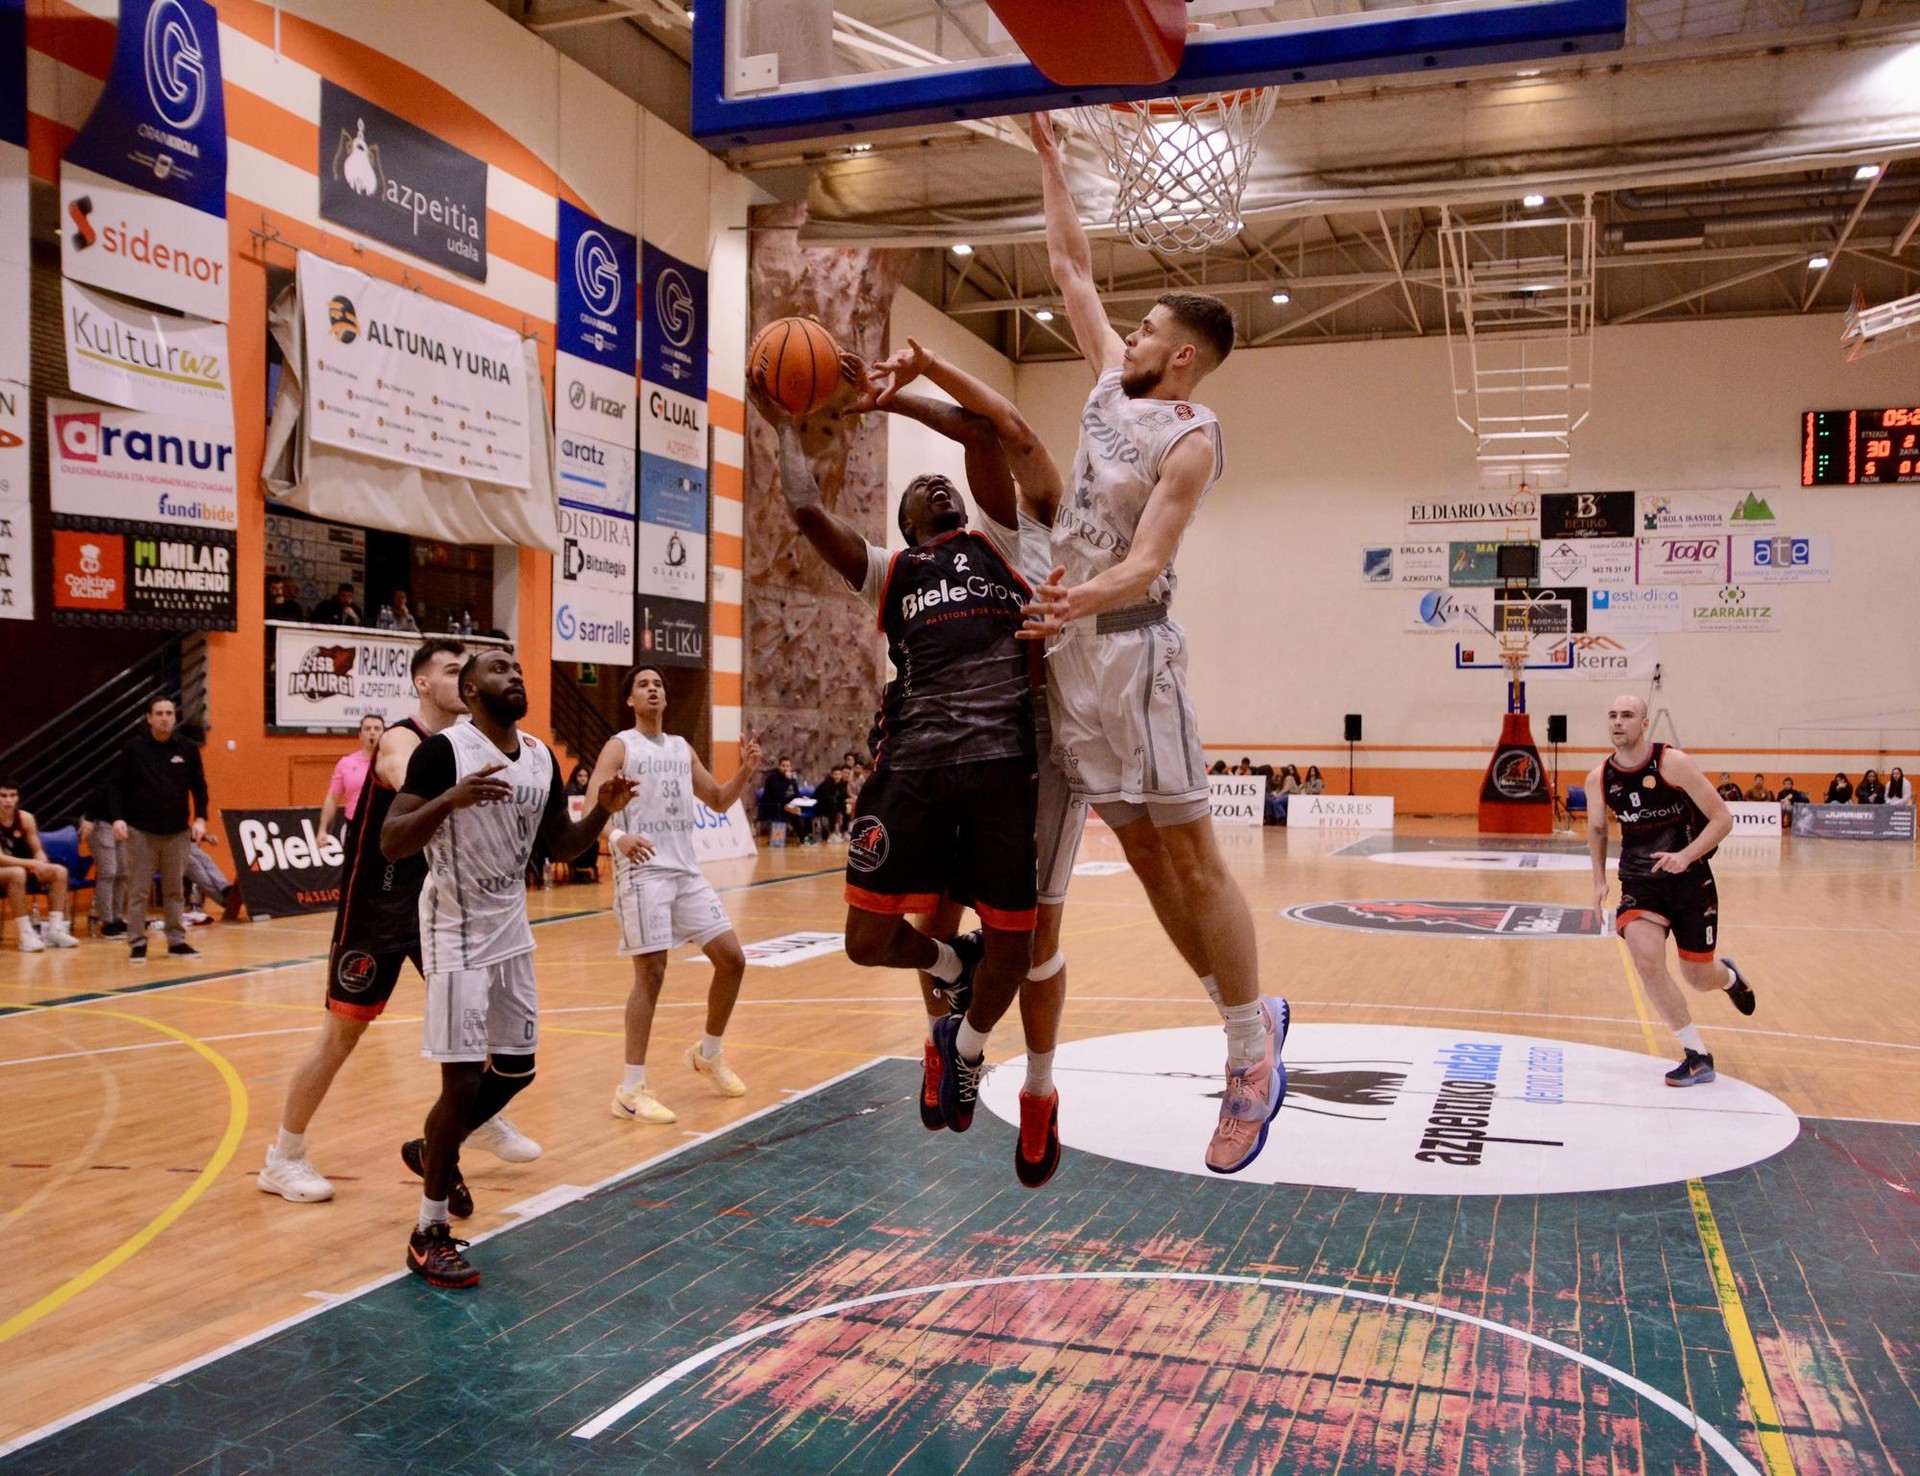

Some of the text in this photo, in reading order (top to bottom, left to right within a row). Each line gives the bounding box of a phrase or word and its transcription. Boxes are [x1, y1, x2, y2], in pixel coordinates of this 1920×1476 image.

[387, 178, 480, 239] azpeitia
[102, 221, 223, 285] sidenor
[446, 236, 480, 262] udala
[72, 306, 221, 380] Kulturaz
[367, 320, 447, 366] ALTUNA
[1882, 408, 1920, 427] 05:2
[63, 419, 232, 472] aranur
[562, 439, 605, 466] aratz
[1866, 440, 1891, 457] 30
[159, 493, 235, 523] fundibide
[1412, 501, 1536, 520] EL DIARIO VASCO
[558, 509, 631, 547] DISDIRA
[160, 541, 229, 573] MILAR
[953, 553, 971, 573] 2
[1754, 538, 1809, 567] ate
[135, 567, 230, 593] LARRAMENDI
[1693, 608, 1771, 618] IZARRAITZ
[579, 619, 630, 646] sarralle
[655, 628, 702, 654] ELIKU
[358, 645, 408, 678] IRAURGI
[289, 671, 355, 698] IRAURGI
[661, 779, 680, 799] 33
[1208, 783, 1256, 797] NTAJES
[1629, 792, 1641, 808] 8
[1210, 804, 1254, 817] ZOLA
[1310, 798, 1373, 815] AÑARES
[1319, 817, 1361, 827] RIOJA
[239, 818, 347, 872] Biele
[297, 891, 341, 906] PASSIO
[1706, 925, 1714, 946] 8
